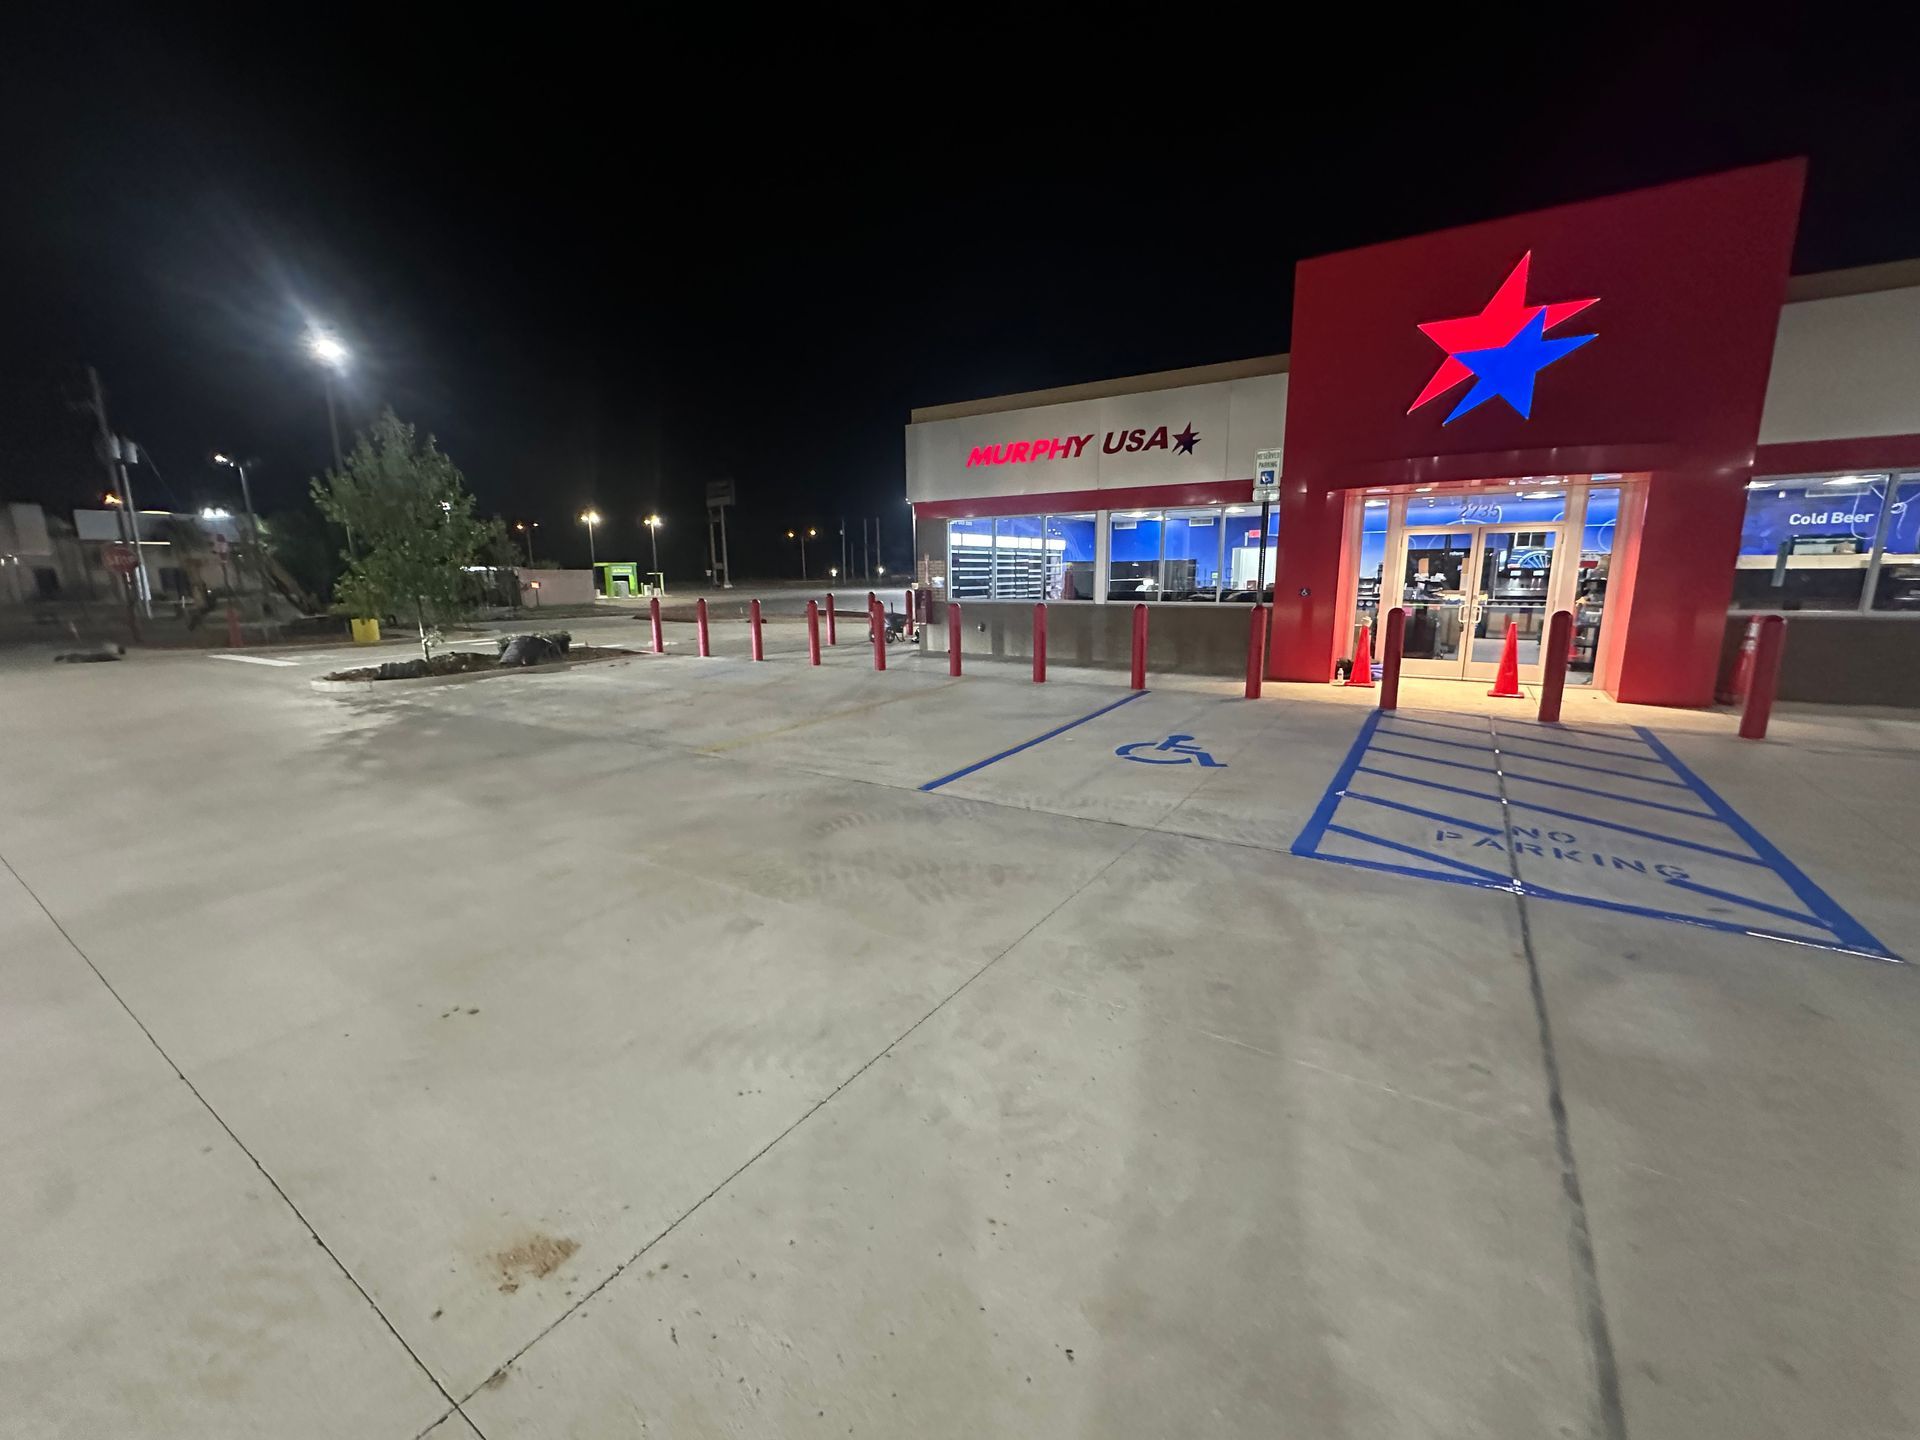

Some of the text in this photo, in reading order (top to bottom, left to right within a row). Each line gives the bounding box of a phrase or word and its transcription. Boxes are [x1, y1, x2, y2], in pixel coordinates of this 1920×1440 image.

[966, 426, 1168, 468] MURPHY USA
[1458, 503, 1500, 518] 2735
[1789, 512, 1874, 525] Cold Beer
[1513, 825, 1576, 843] NO
[1436, 830, 1690, 879] PARKING
